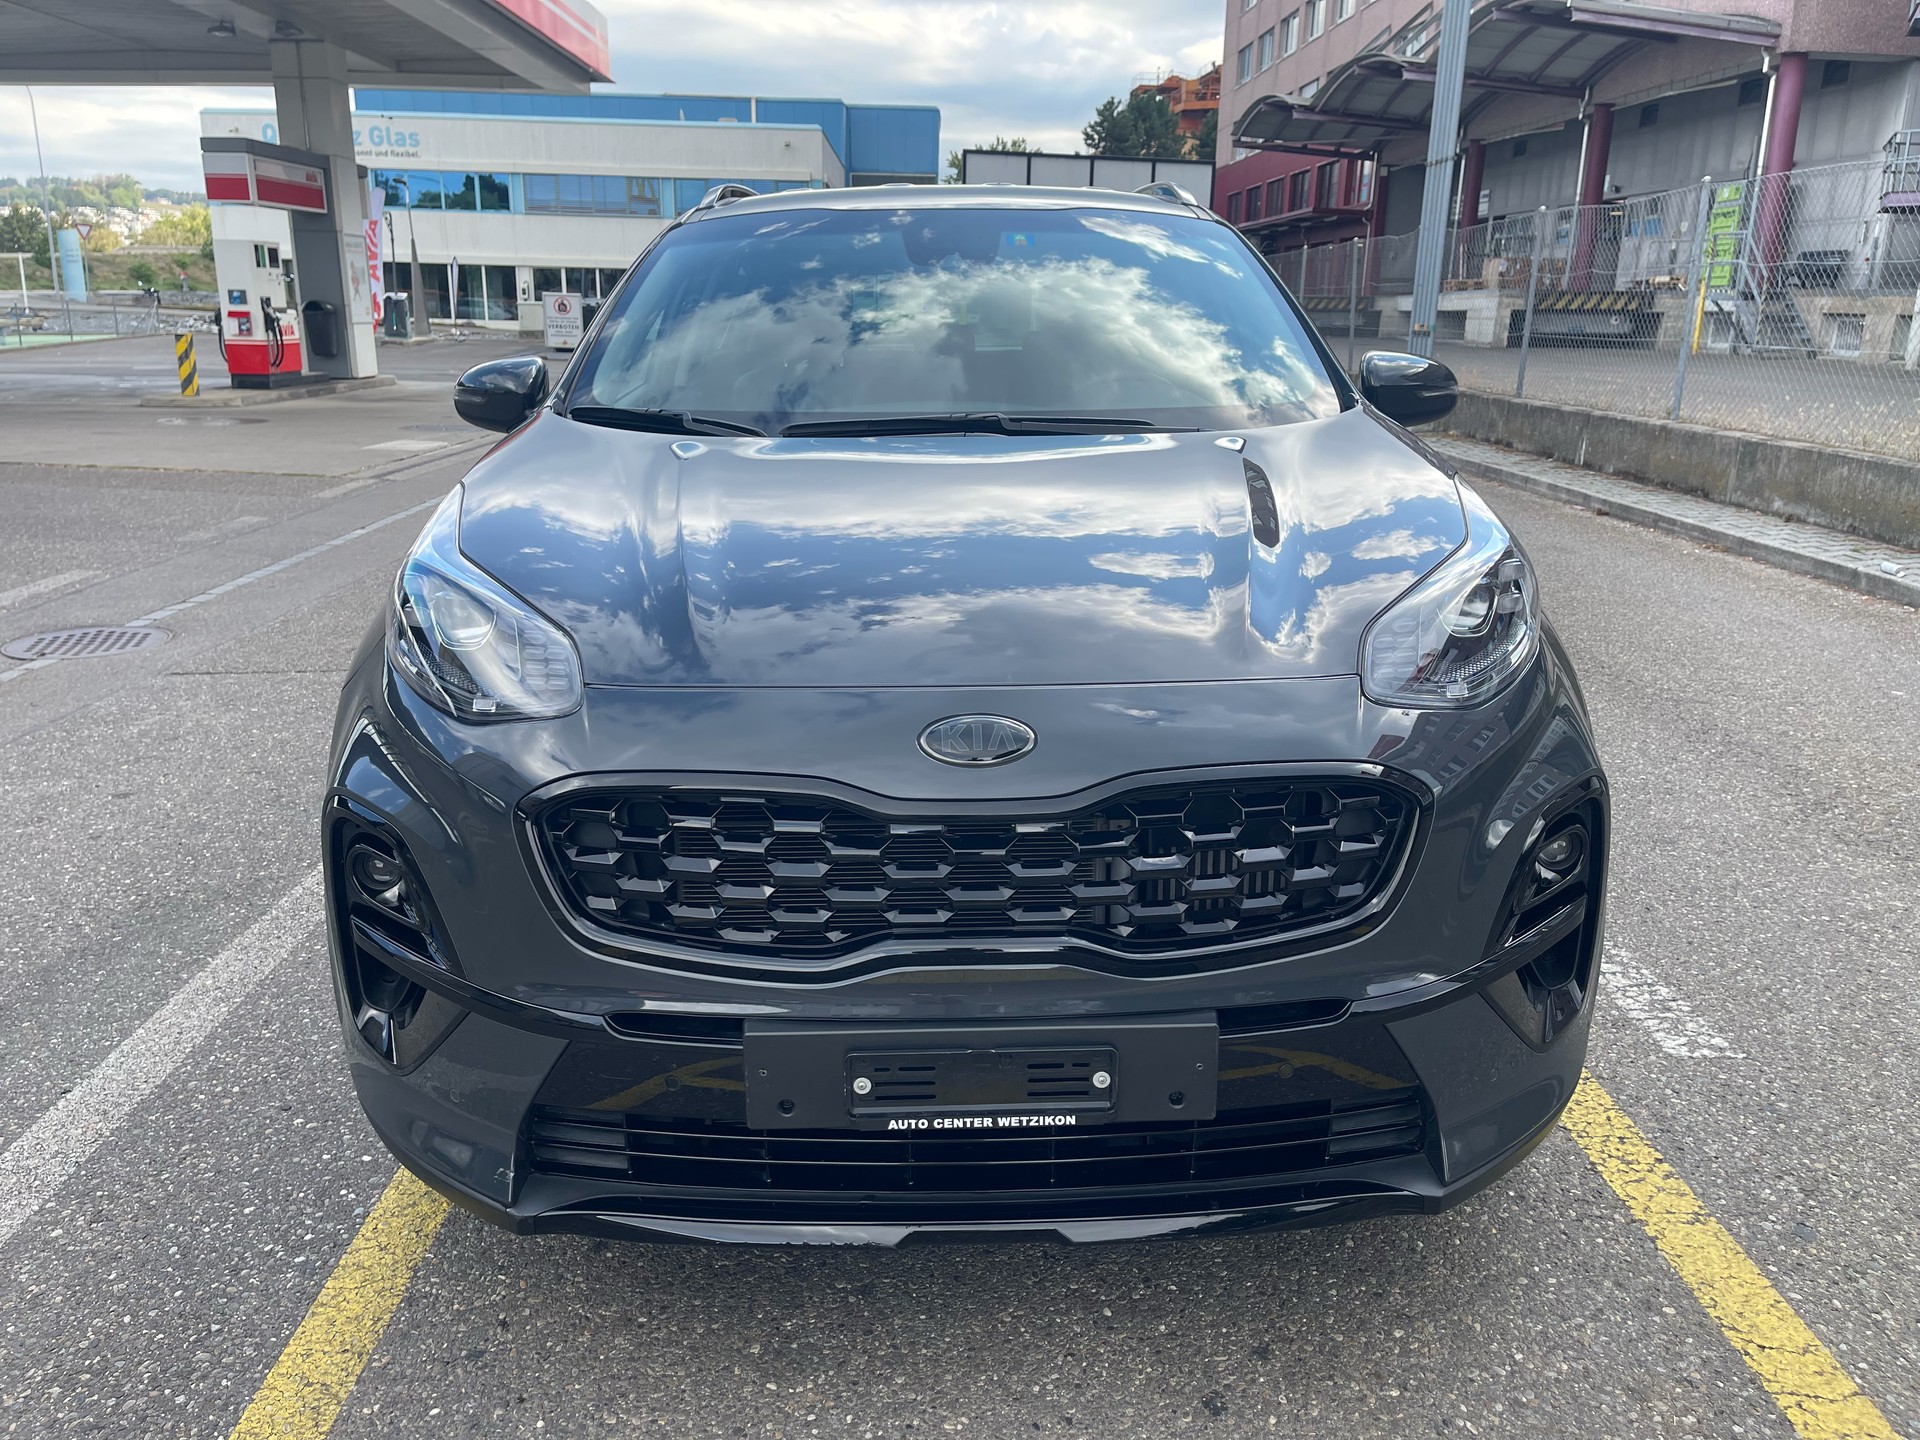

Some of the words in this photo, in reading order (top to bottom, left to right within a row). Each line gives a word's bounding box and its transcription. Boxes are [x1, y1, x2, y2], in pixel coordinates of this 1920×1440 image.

[368, 124, 421, 148] Glas
[374, 149, 389, 157] und
[939, 723, 1017, 753] KIA
[887, 1118, 929, 1130] AUTO
[933, 1117, 993, 1129] CENTER
[997, 1115, 1076, 1127] WETZIKON
